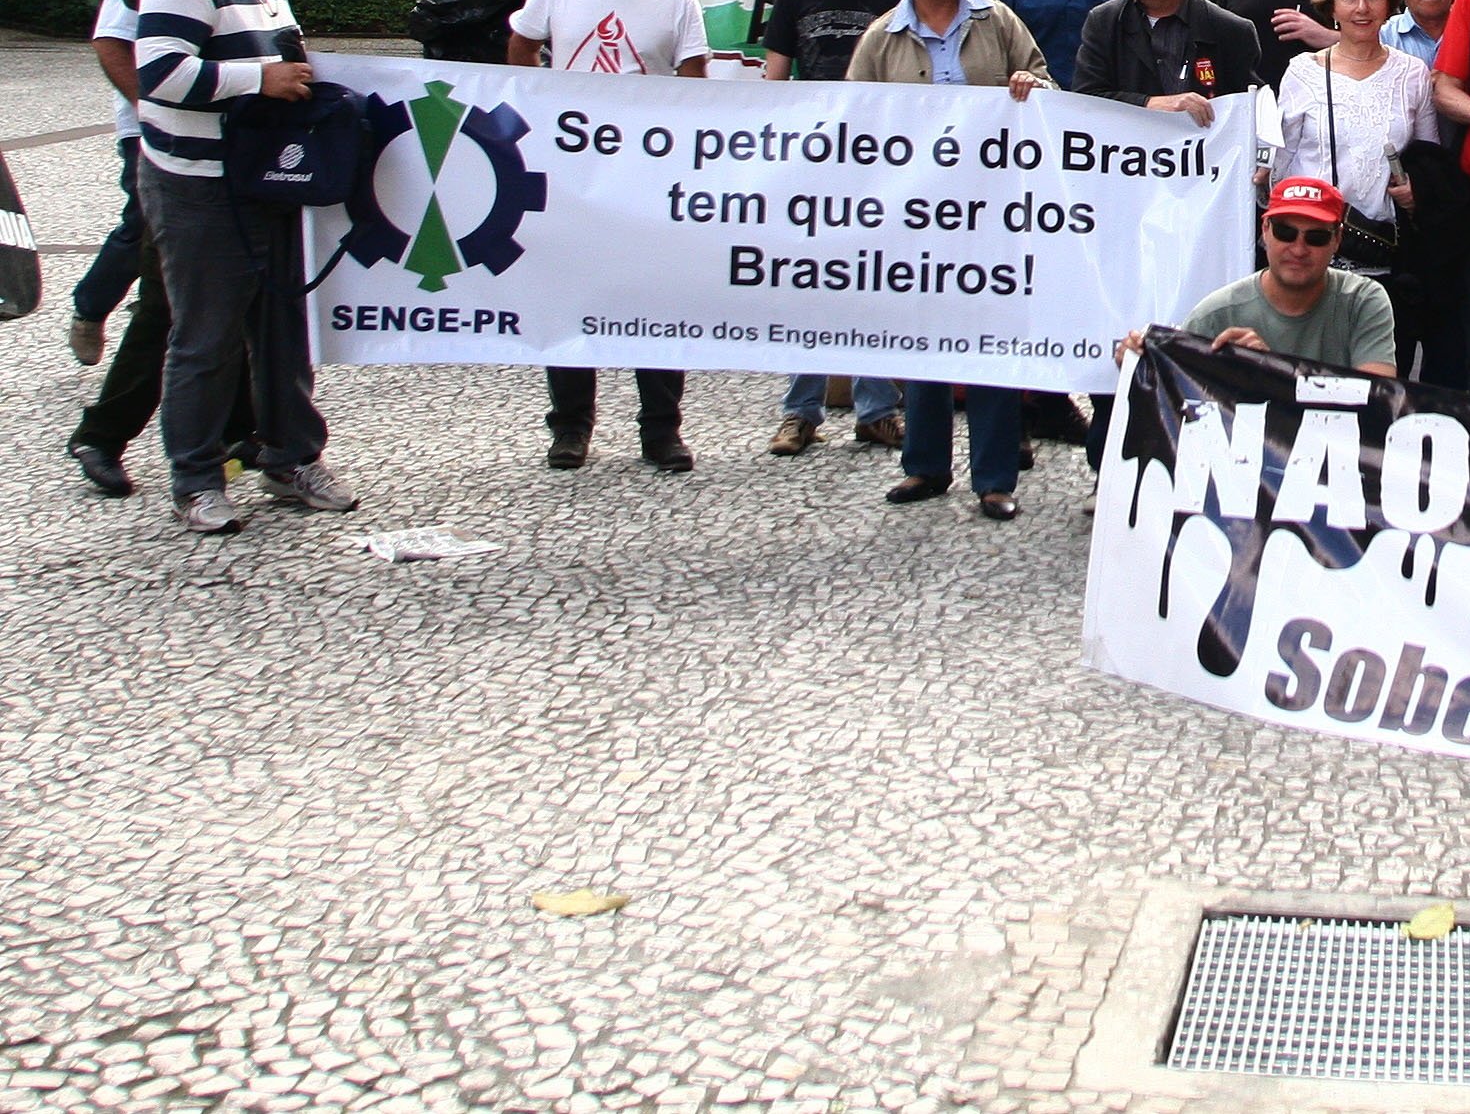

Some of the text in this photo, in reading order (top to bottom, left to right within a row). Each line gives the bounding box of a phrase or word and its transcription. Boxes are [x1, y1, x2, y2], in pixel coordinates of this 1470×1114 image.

[555, 110, 1221, 183] Se o petróleo é do Brasil,
[668, 181, 1096, 237] tem que ser dos
[730, 246, 1035, 296] Brasileiros!
[331, 305, 522, 336] SENGE-PR
[581, 315, 704, 340] Sindicato
[712, 320, 758, 342] dos
[768, 324, 929, 352] Engenheiros
[938, 335, 970, 354] no
[979, 334, 1065, 358] Estado
[1072, 336, 1102, 360] do
[1173, 374, 1470, 534] NÃO
